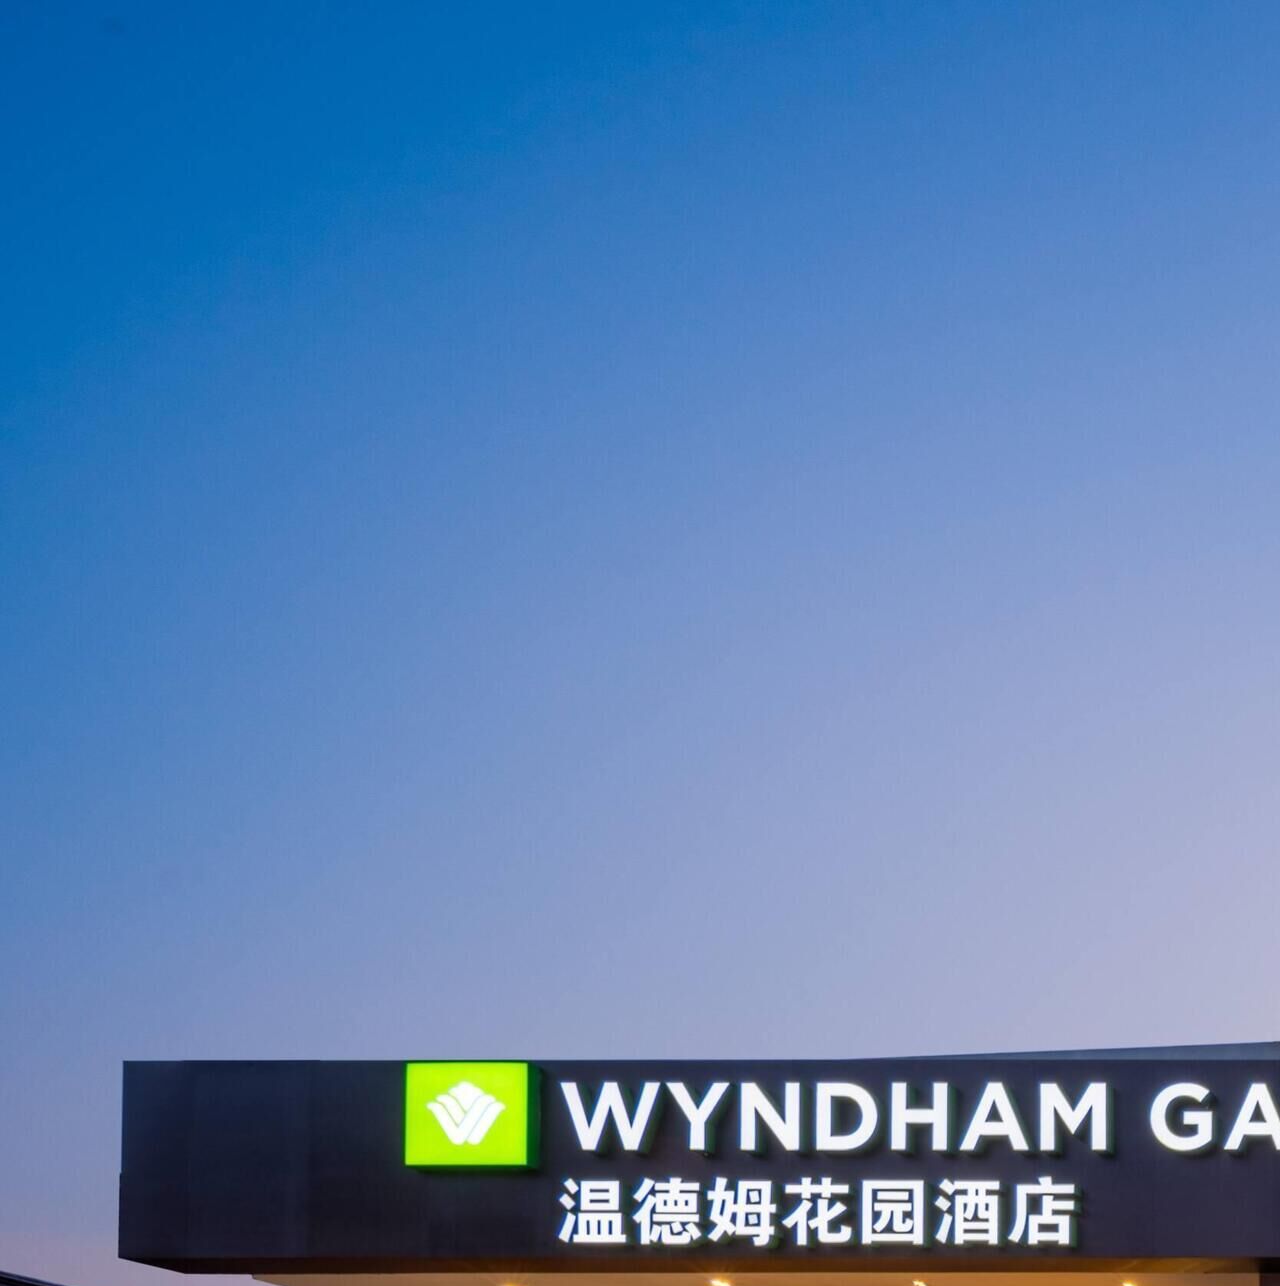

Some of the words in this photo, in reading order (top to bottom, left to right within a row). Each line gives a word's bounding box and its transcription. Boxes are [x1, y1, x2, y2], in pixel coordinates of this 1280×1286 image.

[560, 1081, 1108, 1151] WYNDHAM
[558, 1176, 1076, 1247] 温德姆花园酒店
